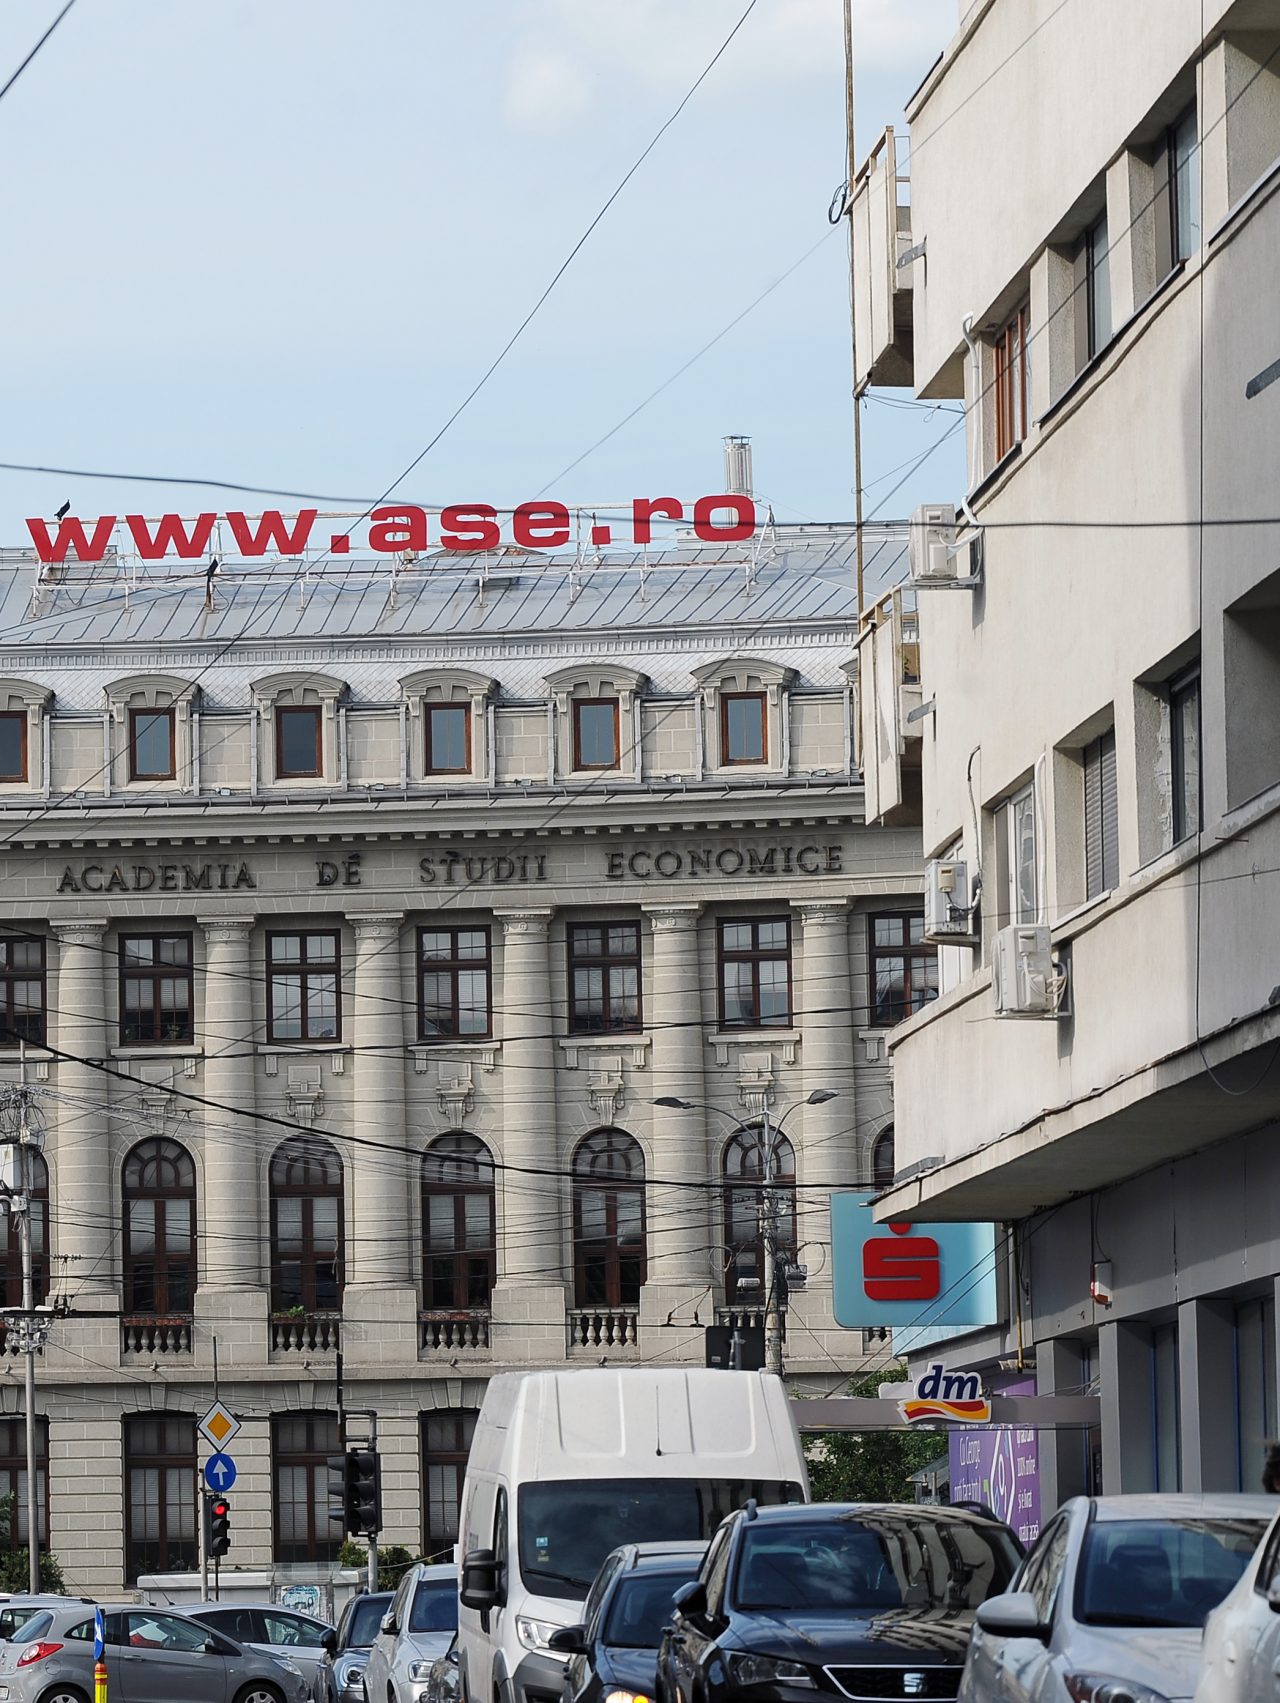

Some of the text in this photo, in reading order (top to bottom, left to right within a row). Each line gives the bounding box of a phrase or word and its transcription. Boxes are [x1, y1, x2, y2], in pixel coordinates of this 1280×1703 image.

[25, 494, 756, 562] www.ase.ro
[56, 845, 843, 892] ACADEMIA DE STUDII ECONOMICE
[918, 1364, 979, 1400] dm
[966, 1435, 981, 1470] George
